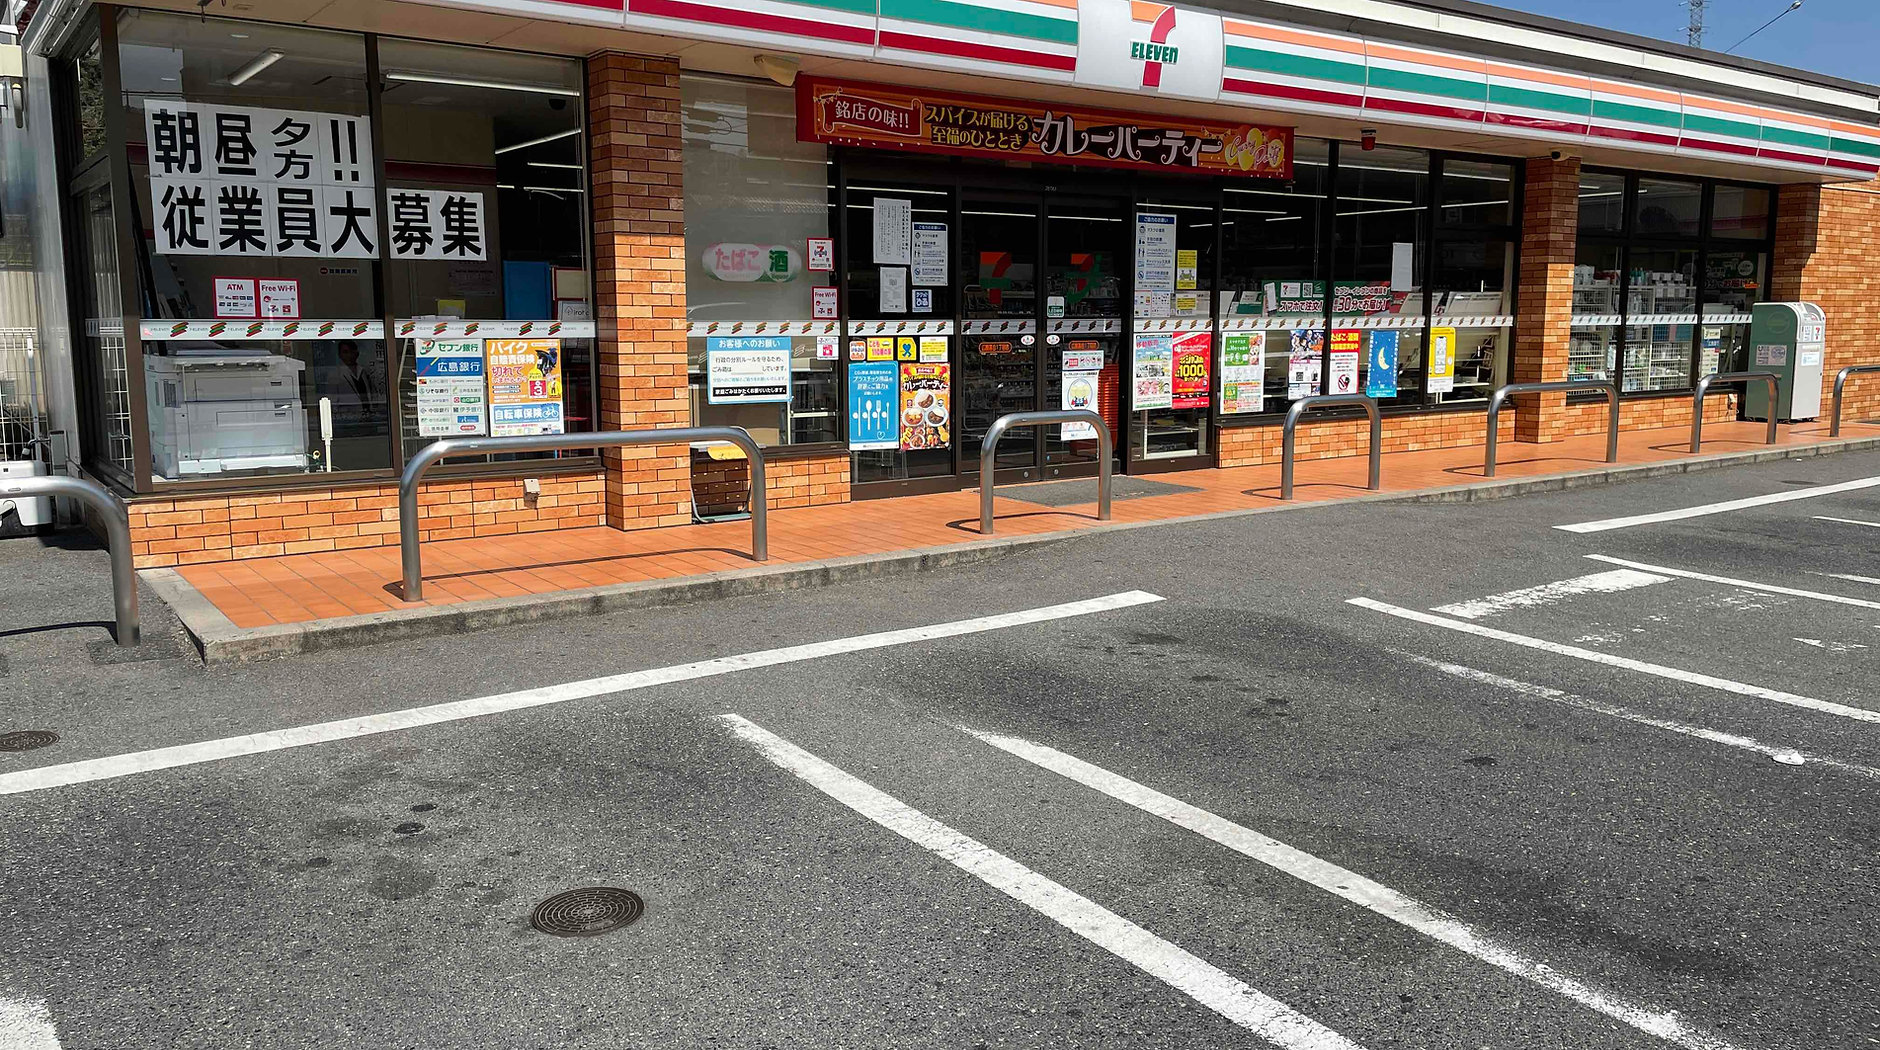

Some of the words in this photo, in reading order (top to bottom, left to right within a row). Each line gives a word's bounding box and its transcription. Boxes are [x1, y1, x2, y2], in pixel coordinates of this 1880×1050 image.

[834, 99, 909, 130] 銘店の味!!
[924, 104, 1029, 131] スパイスが届ける
[931, 125, 1023, 151] 至福のひととき
[1032, 110, 1222, 167] カレーパーティー
[715, 247, 760, 271] たばこ
[769, 249, 789, 272] 酒
[226, 283, 244, 291] ATM
[261, 284, 276, 292] Free
[277, 284, 296, 292] Wi-Fi
[1279, 300, 1324, 312] スマホで注文!
[438, 343, 479, 352] セブン銀行
[489, 341, 529, 354] バイク
[718, 339, 781, 349] お客様へのお願い
[437, 361, 480, 372] 広島銀行
[491, 365, 523, 377] 切れて
[1179, 364, 1204, 377] 1000
[494, 407, 542, 420] 自転車保険
